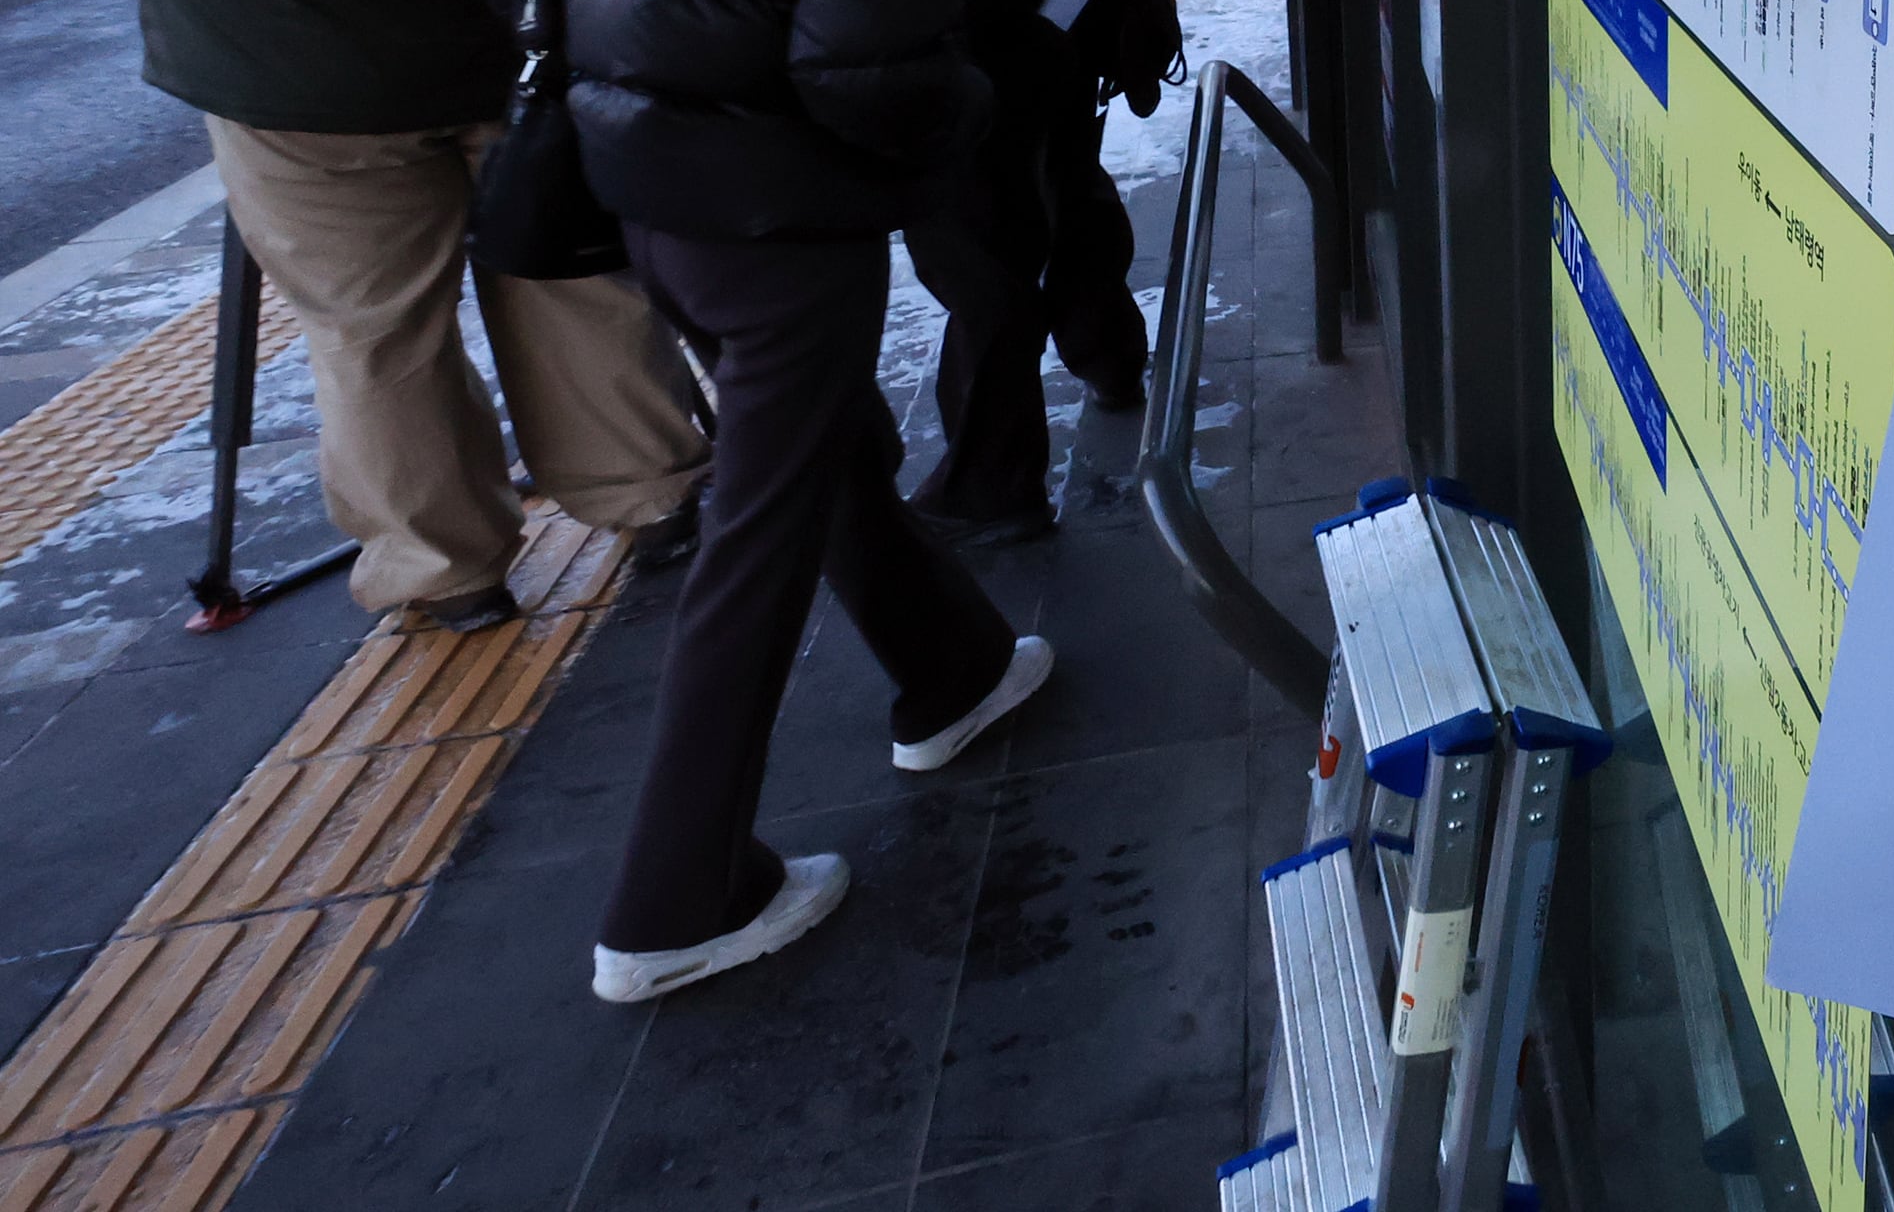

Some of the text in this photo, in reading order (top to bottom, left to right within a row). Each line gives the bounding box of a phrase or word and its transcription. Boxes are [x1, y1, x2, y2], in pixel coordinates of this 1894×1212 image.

[1563, 200, 1584, 293] N75
[1738, 151, 1825, 282] 우이동 남태령역
